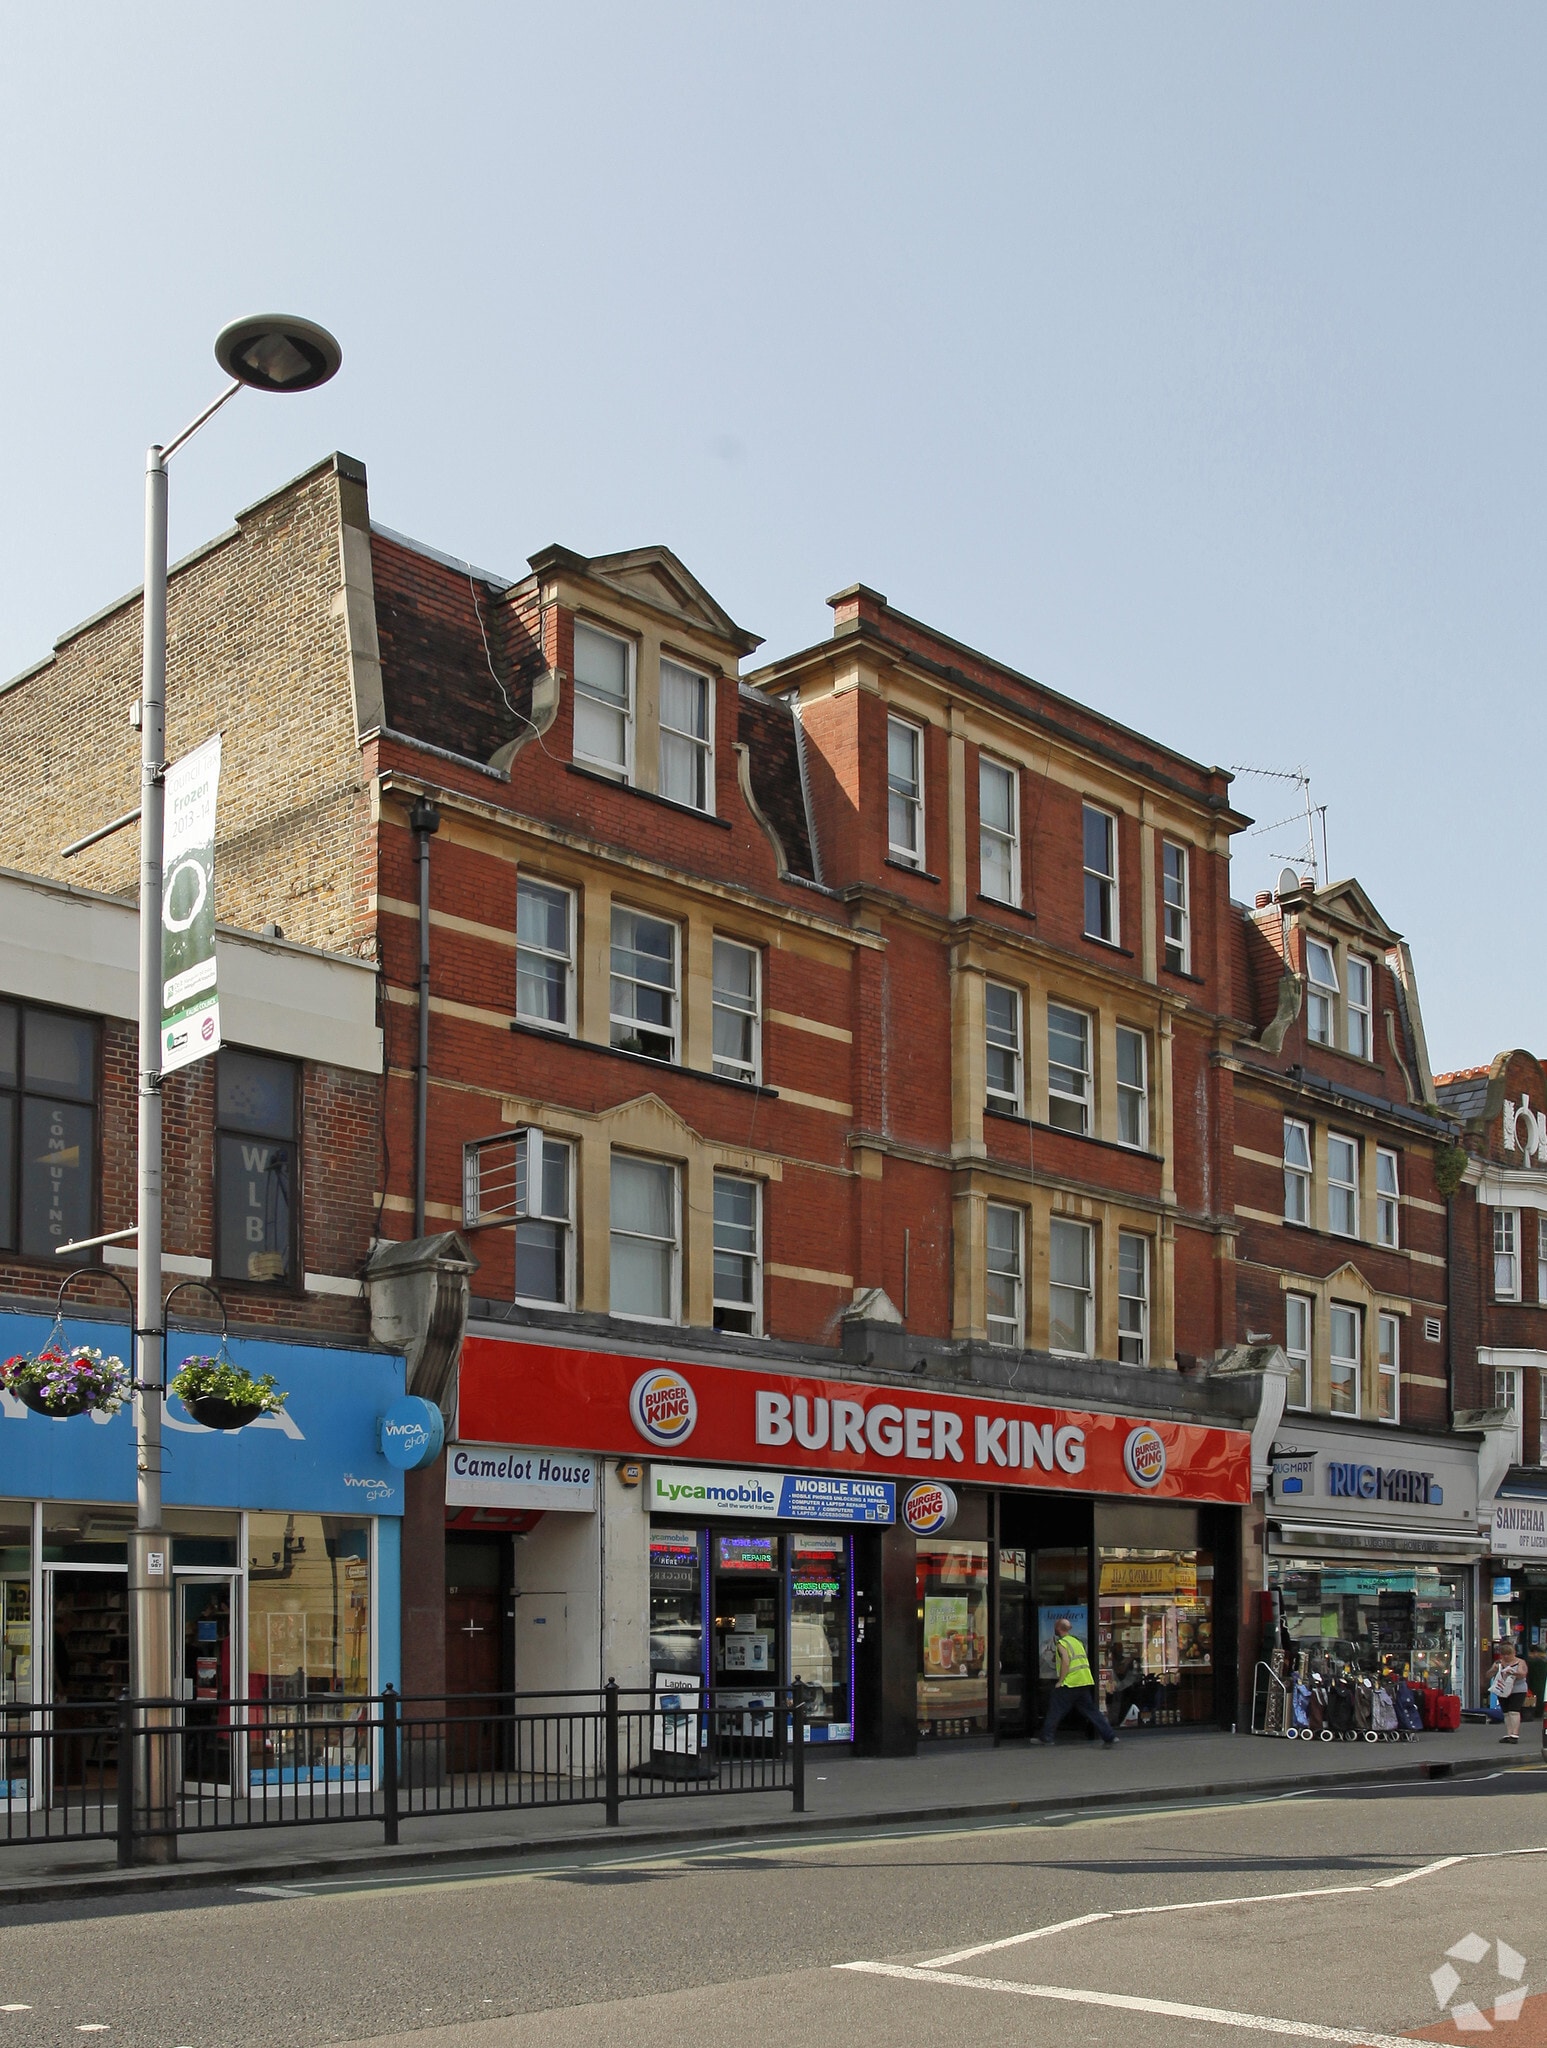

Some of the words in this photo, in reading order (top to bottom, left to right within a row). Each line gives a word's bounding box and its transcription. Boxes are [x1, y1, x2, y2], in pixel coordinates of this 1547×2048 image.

[168, 760, 200, 796] Council
[203, 753, 218, 772] Tax
[174, 781, 209, 814] Frozen
[645, 1387, 688, 1408] BURGER
[647, 1398, 690, 1425] KING
[755, 1390, 965, 1463] BURGER
[974, 1415, 1086, 1475] KING
[1135, 1441, 1160, 1457] BURGER
[1135, 1449, 1162, 1471] KING
[453, 1452, 532, 1480] Camelot
[538, 1459, 591, 1484] House
[656, 1479, 775, 1503] Lycamobile
[795, 1480, 848, 1495] MOBILE
[852, 1484, 885, 1497] KING
[1328, 1461, 1435, 1505] RUGMART
[907, 1491, 942, 1511] BURGER
[908, 1500, 943, 1524] KING
[1496, 1506, 1545, 1532] SANJEHAA
[650, 1533, 689, 1543] ycamobile
[800, 1539, 836, 1547] Lycamobile
[1519, 1535, 1530, 1547] OFF
[741, 1554, 771, 1562] REPAIRS
